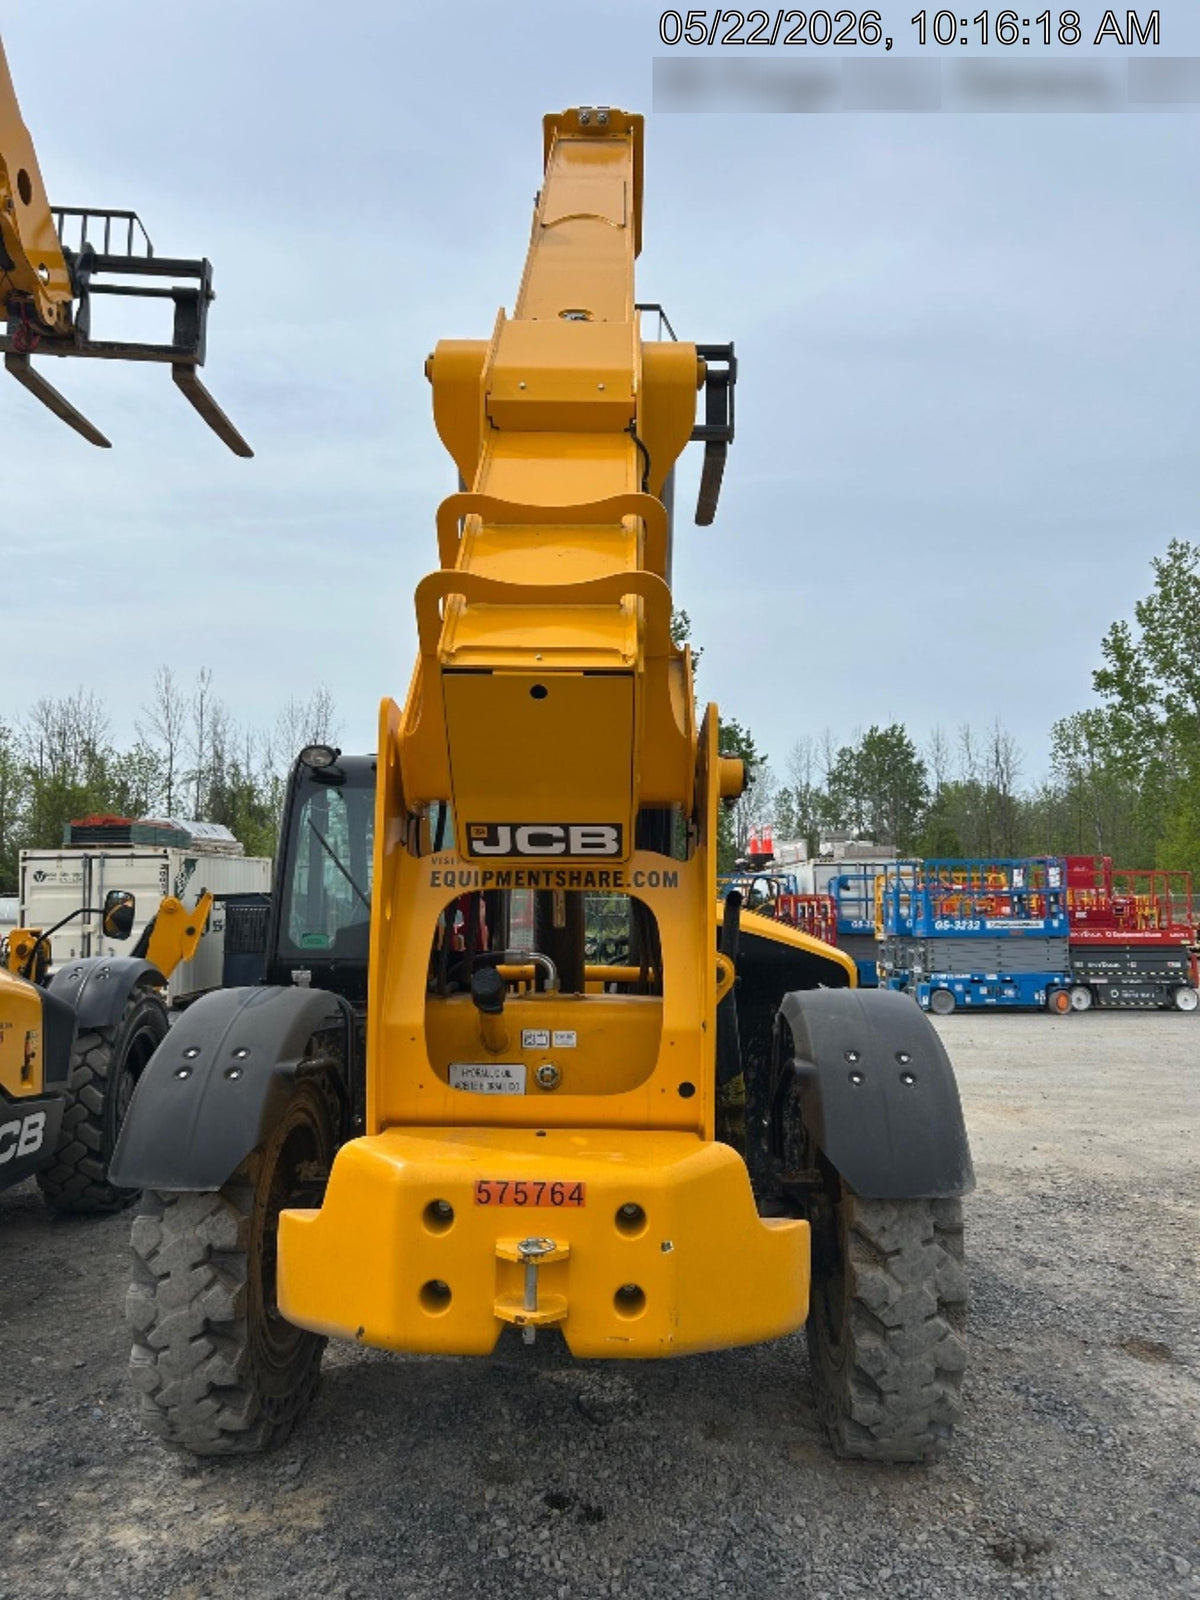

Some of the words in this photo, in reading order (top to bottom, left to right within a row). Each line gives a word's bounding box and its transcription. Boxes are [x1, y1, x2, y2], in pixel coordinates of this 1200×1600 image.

[472, 826, 619, 854] JCB
[430, 870, 679, 888] EQUIPMENTSHARE.COM
[477, 1181, 584, 1206] 575764
